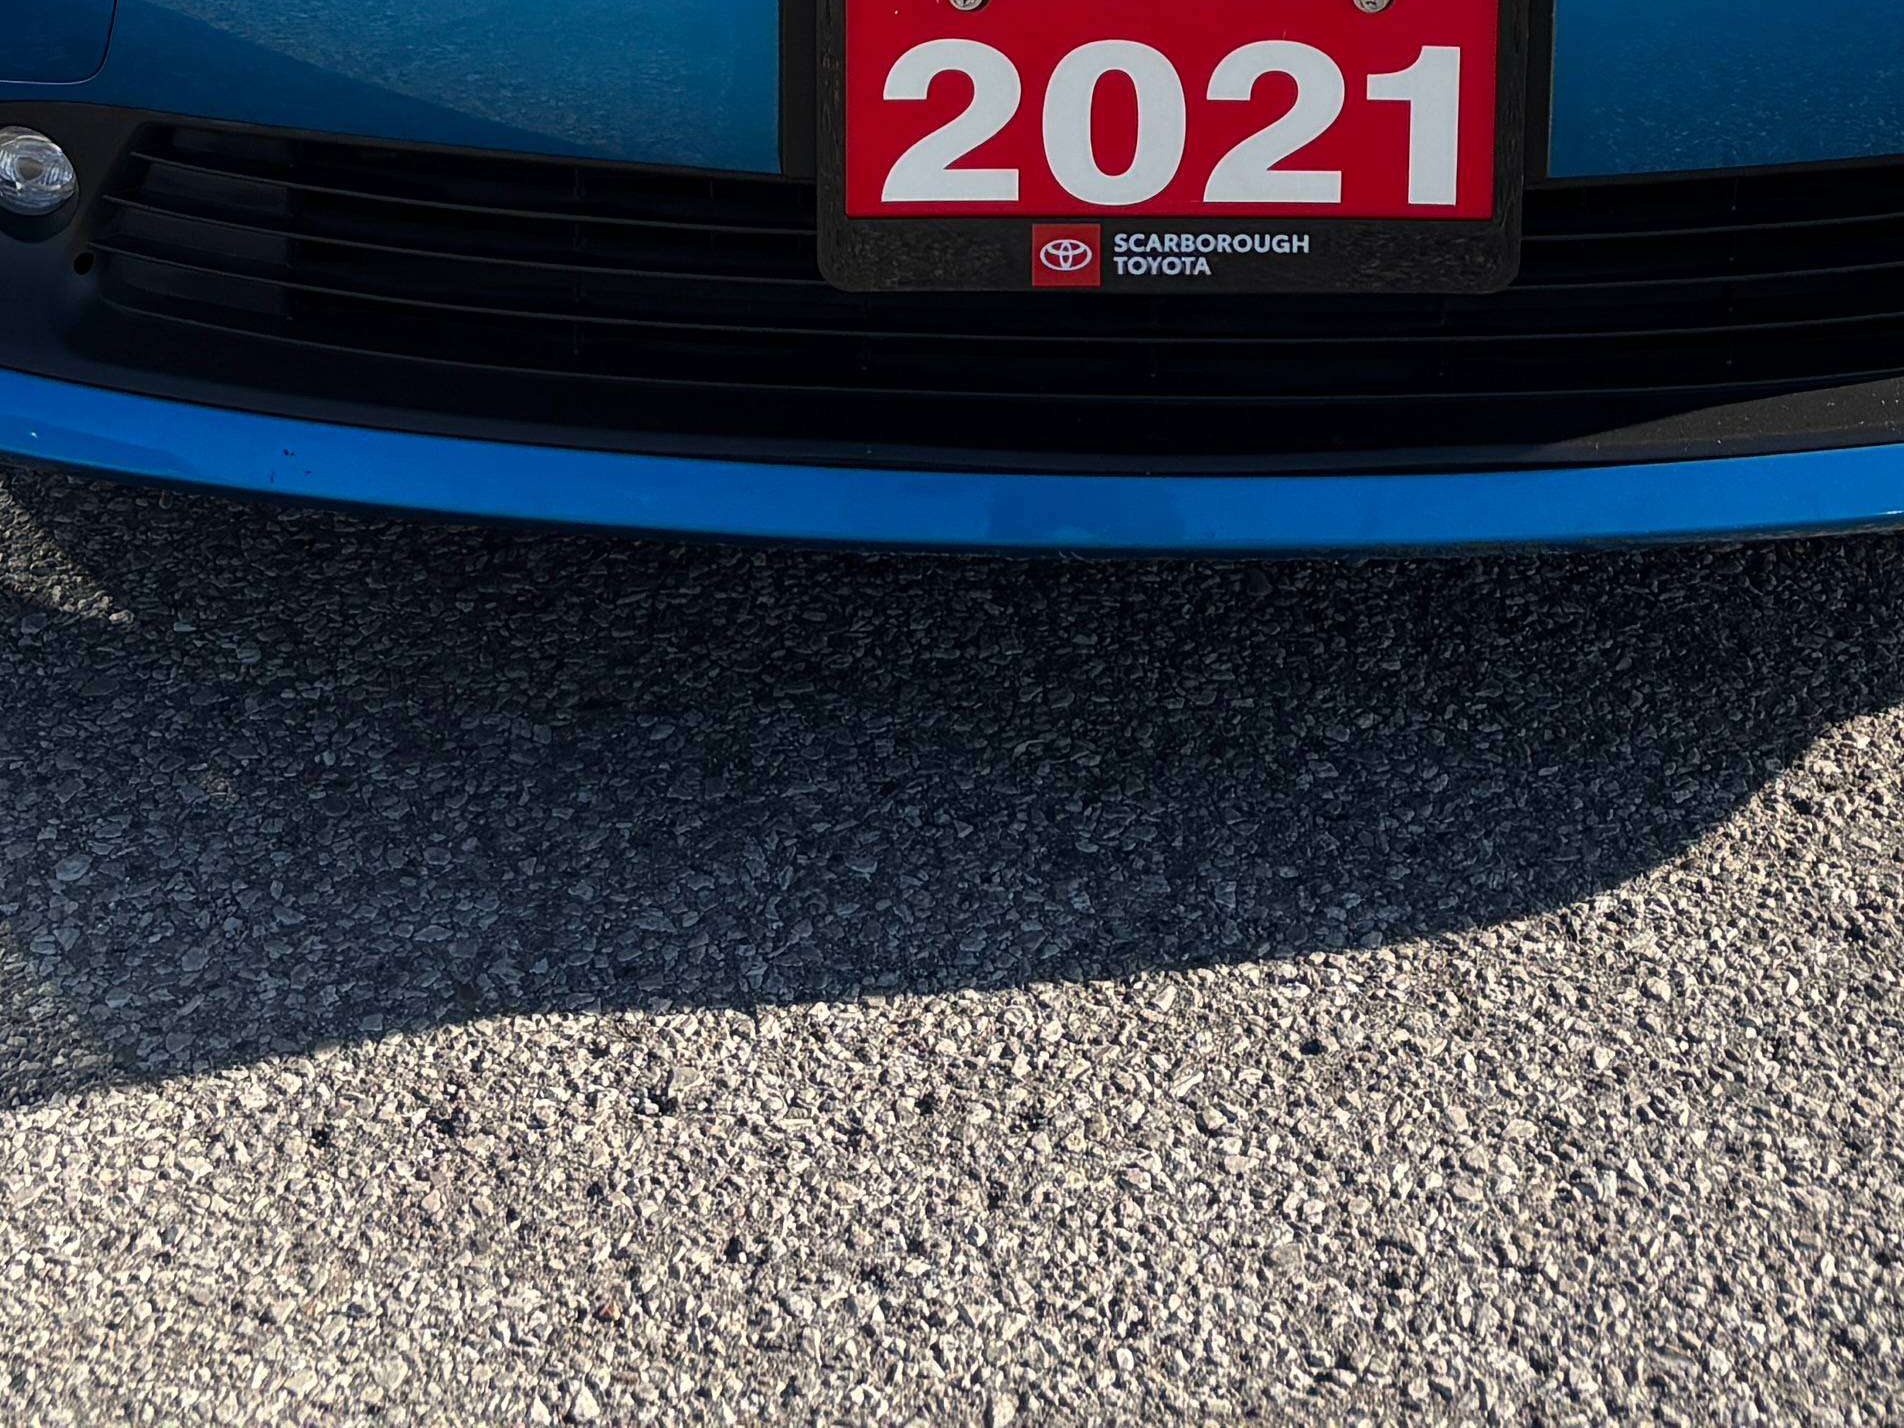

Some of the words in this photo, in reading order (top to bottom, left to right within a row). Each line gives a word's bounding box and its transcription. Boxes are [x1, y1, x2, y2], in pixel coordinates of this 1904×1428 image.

[880, 38, 1461, 206] 2021
[1113, 233, 1310, 255] SCARBOROUGH
[1113, 256, 1212, 277] TOYOTA
